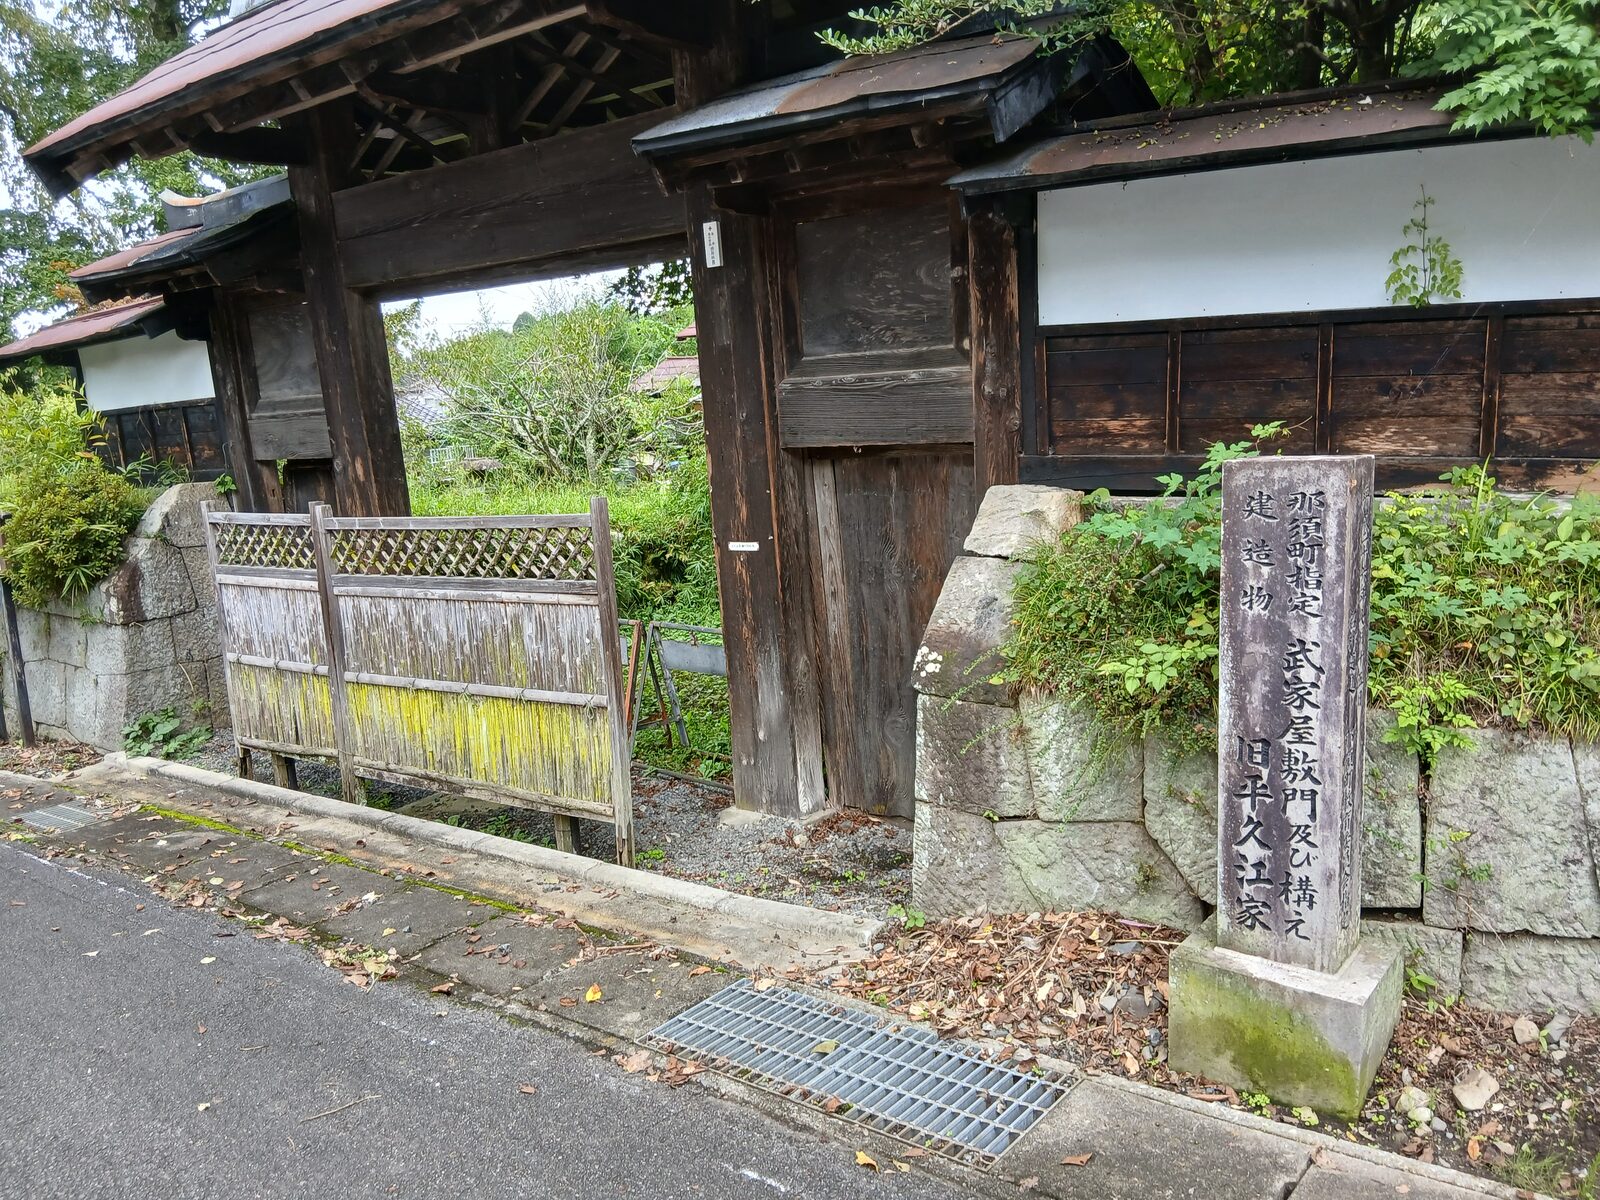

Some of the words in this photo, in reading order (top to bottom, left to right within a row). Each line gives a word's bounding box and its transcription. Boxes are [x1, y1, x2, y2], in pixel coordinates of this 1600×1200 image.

[1240, 490, 1280, 612] 建造物
[1285, 490, 1326, 619] 那須町指定
[1233, 735, 1274, 932] 旧平久江家
[1277, 638, 1326, 941] 武家屋敷門及び構え
